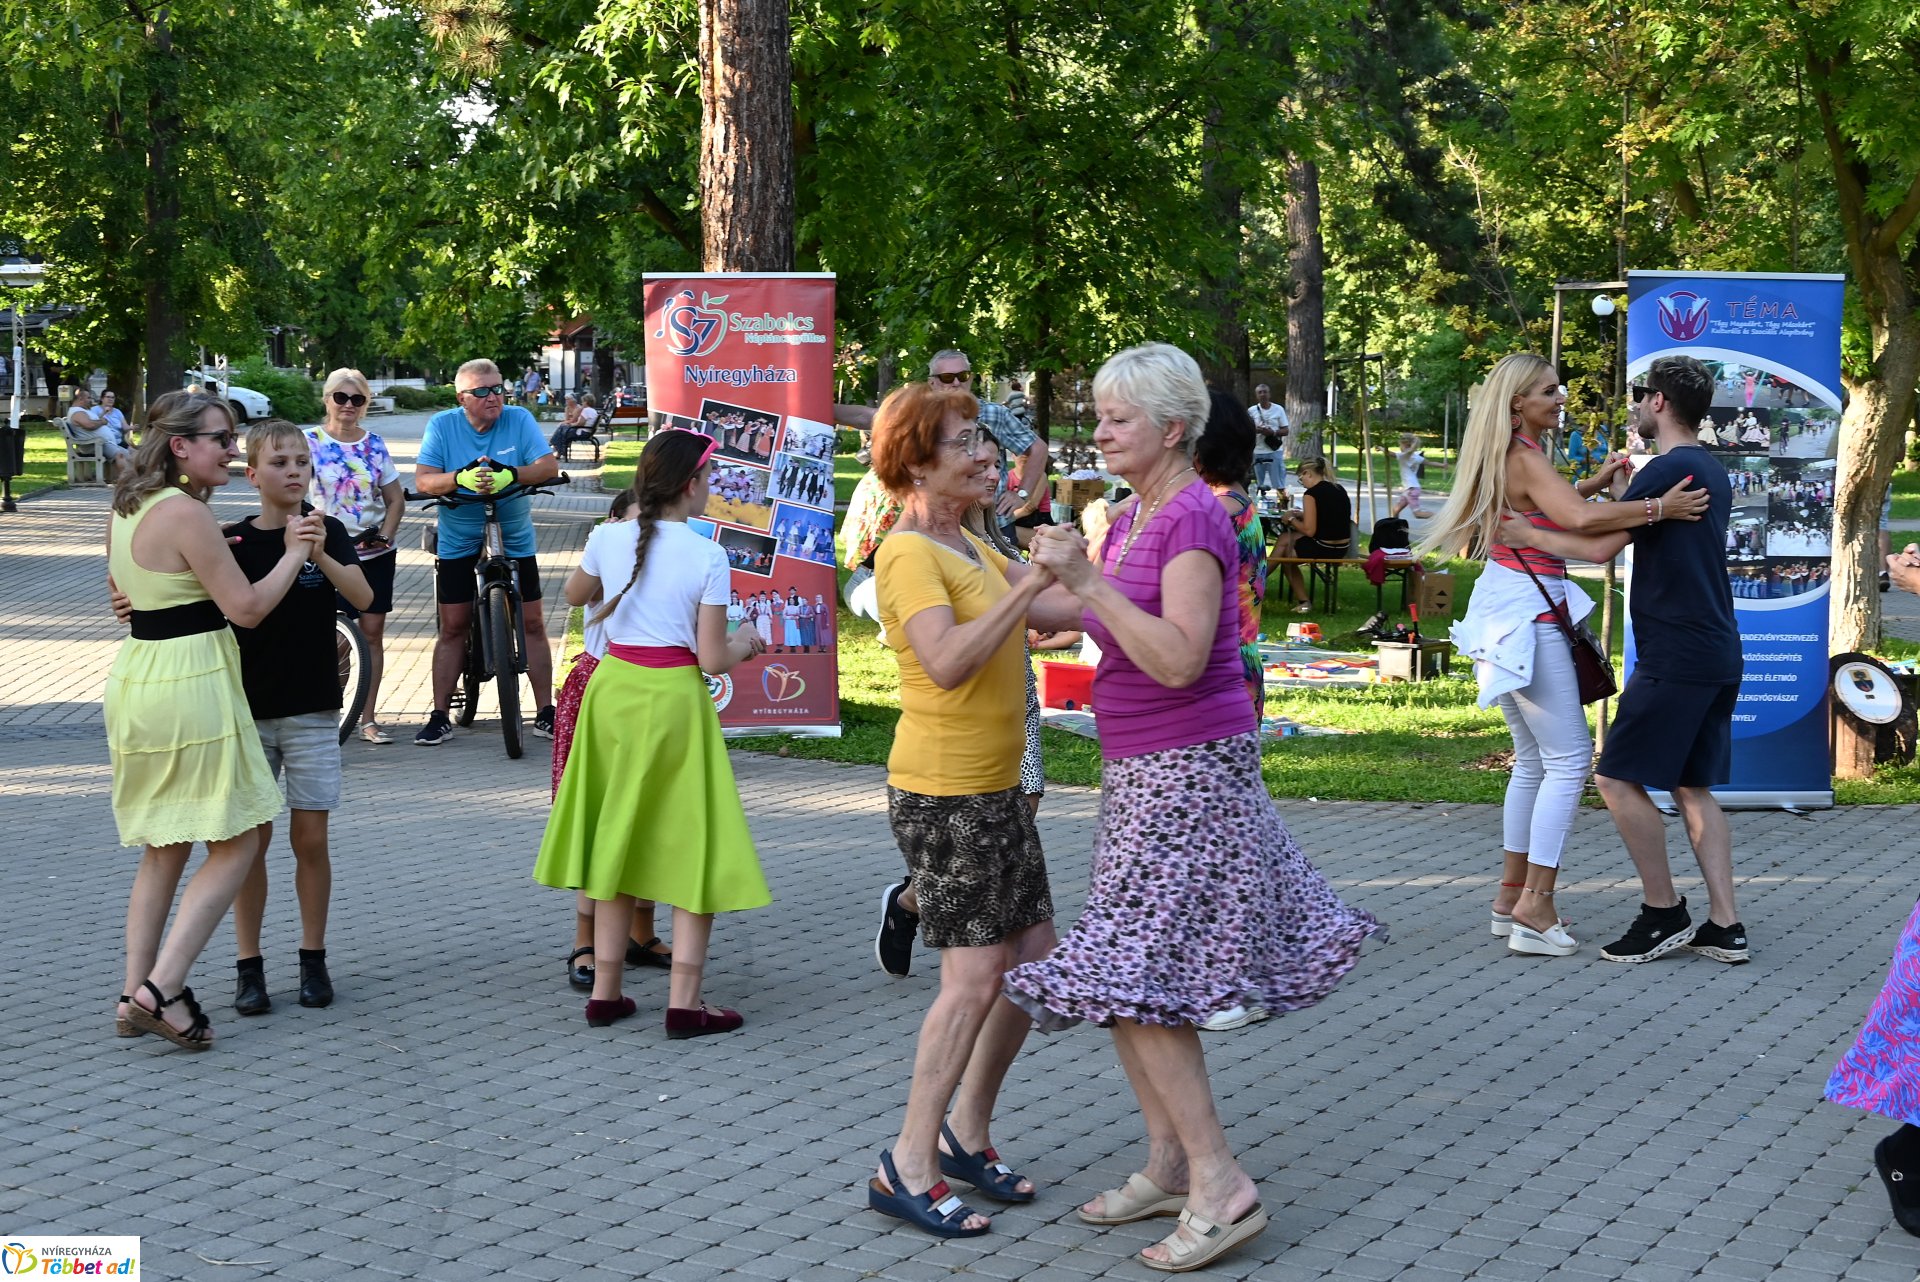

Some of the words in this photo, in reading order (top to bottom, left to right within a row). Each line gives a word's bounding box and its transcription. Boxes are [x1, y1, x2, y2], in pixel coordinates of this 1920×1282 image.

[1726, 295, 1798, 320] TÉMA
[729, 313, 815, 332] Szabolcs
[684, 364, 798, 388] Nyíregyháza
[1740, 633, 1819, 642] ENDEZVÉNYSZERVEZÉS
[1764, 673, 1797, 682] ÉLETMÓD
